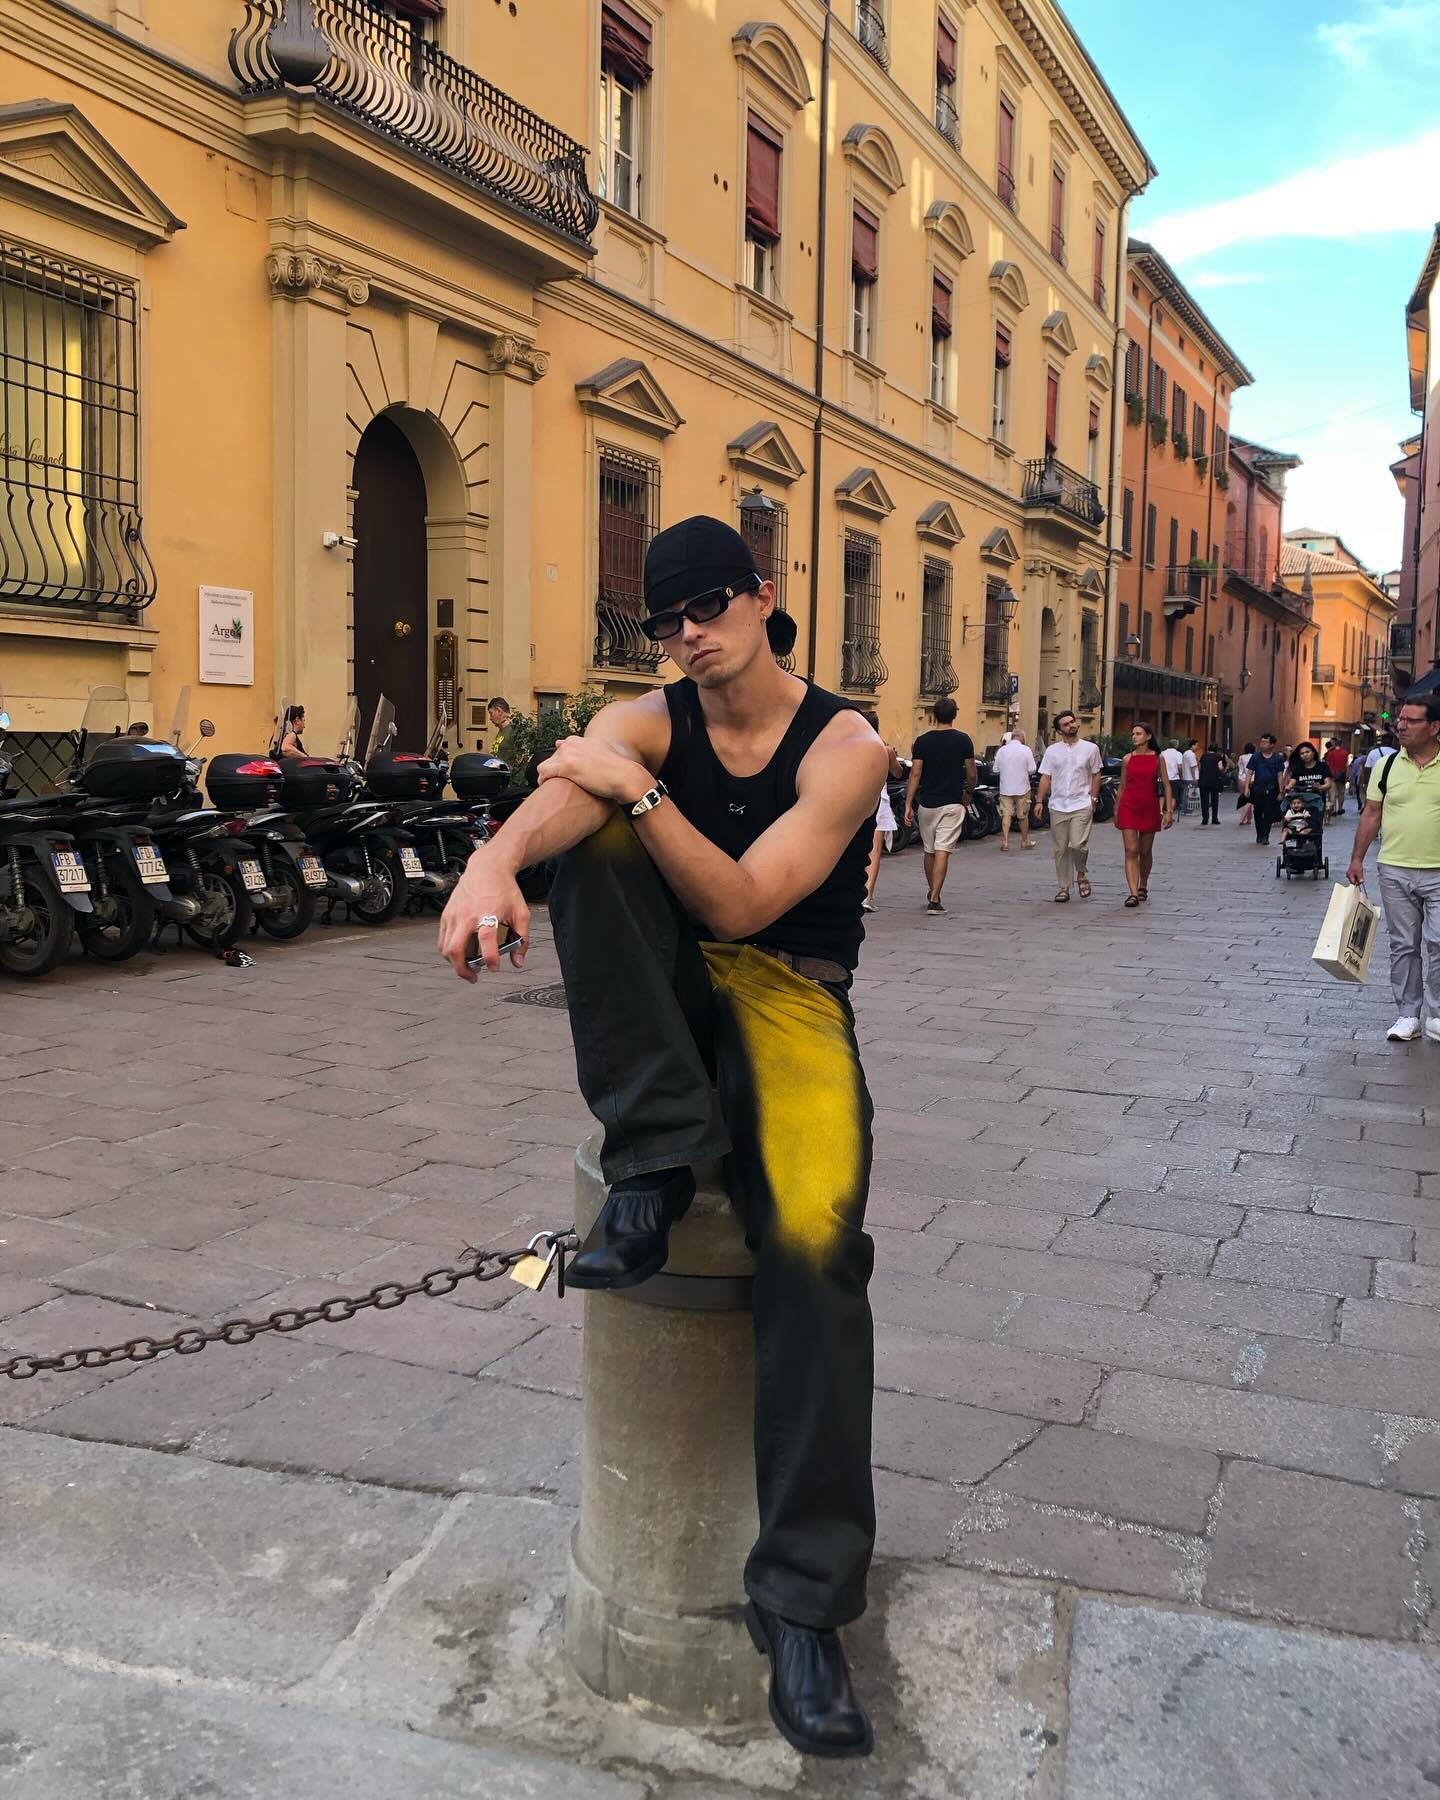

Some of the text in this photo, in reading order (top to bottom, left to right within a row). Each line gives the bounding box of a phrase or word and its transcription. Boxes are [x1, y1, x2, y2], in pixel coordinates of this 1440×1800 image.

[1011, 677, 1018, 692] P
[59, 853, 71, 865] FB
[58, 868, 84, 881] 37217
